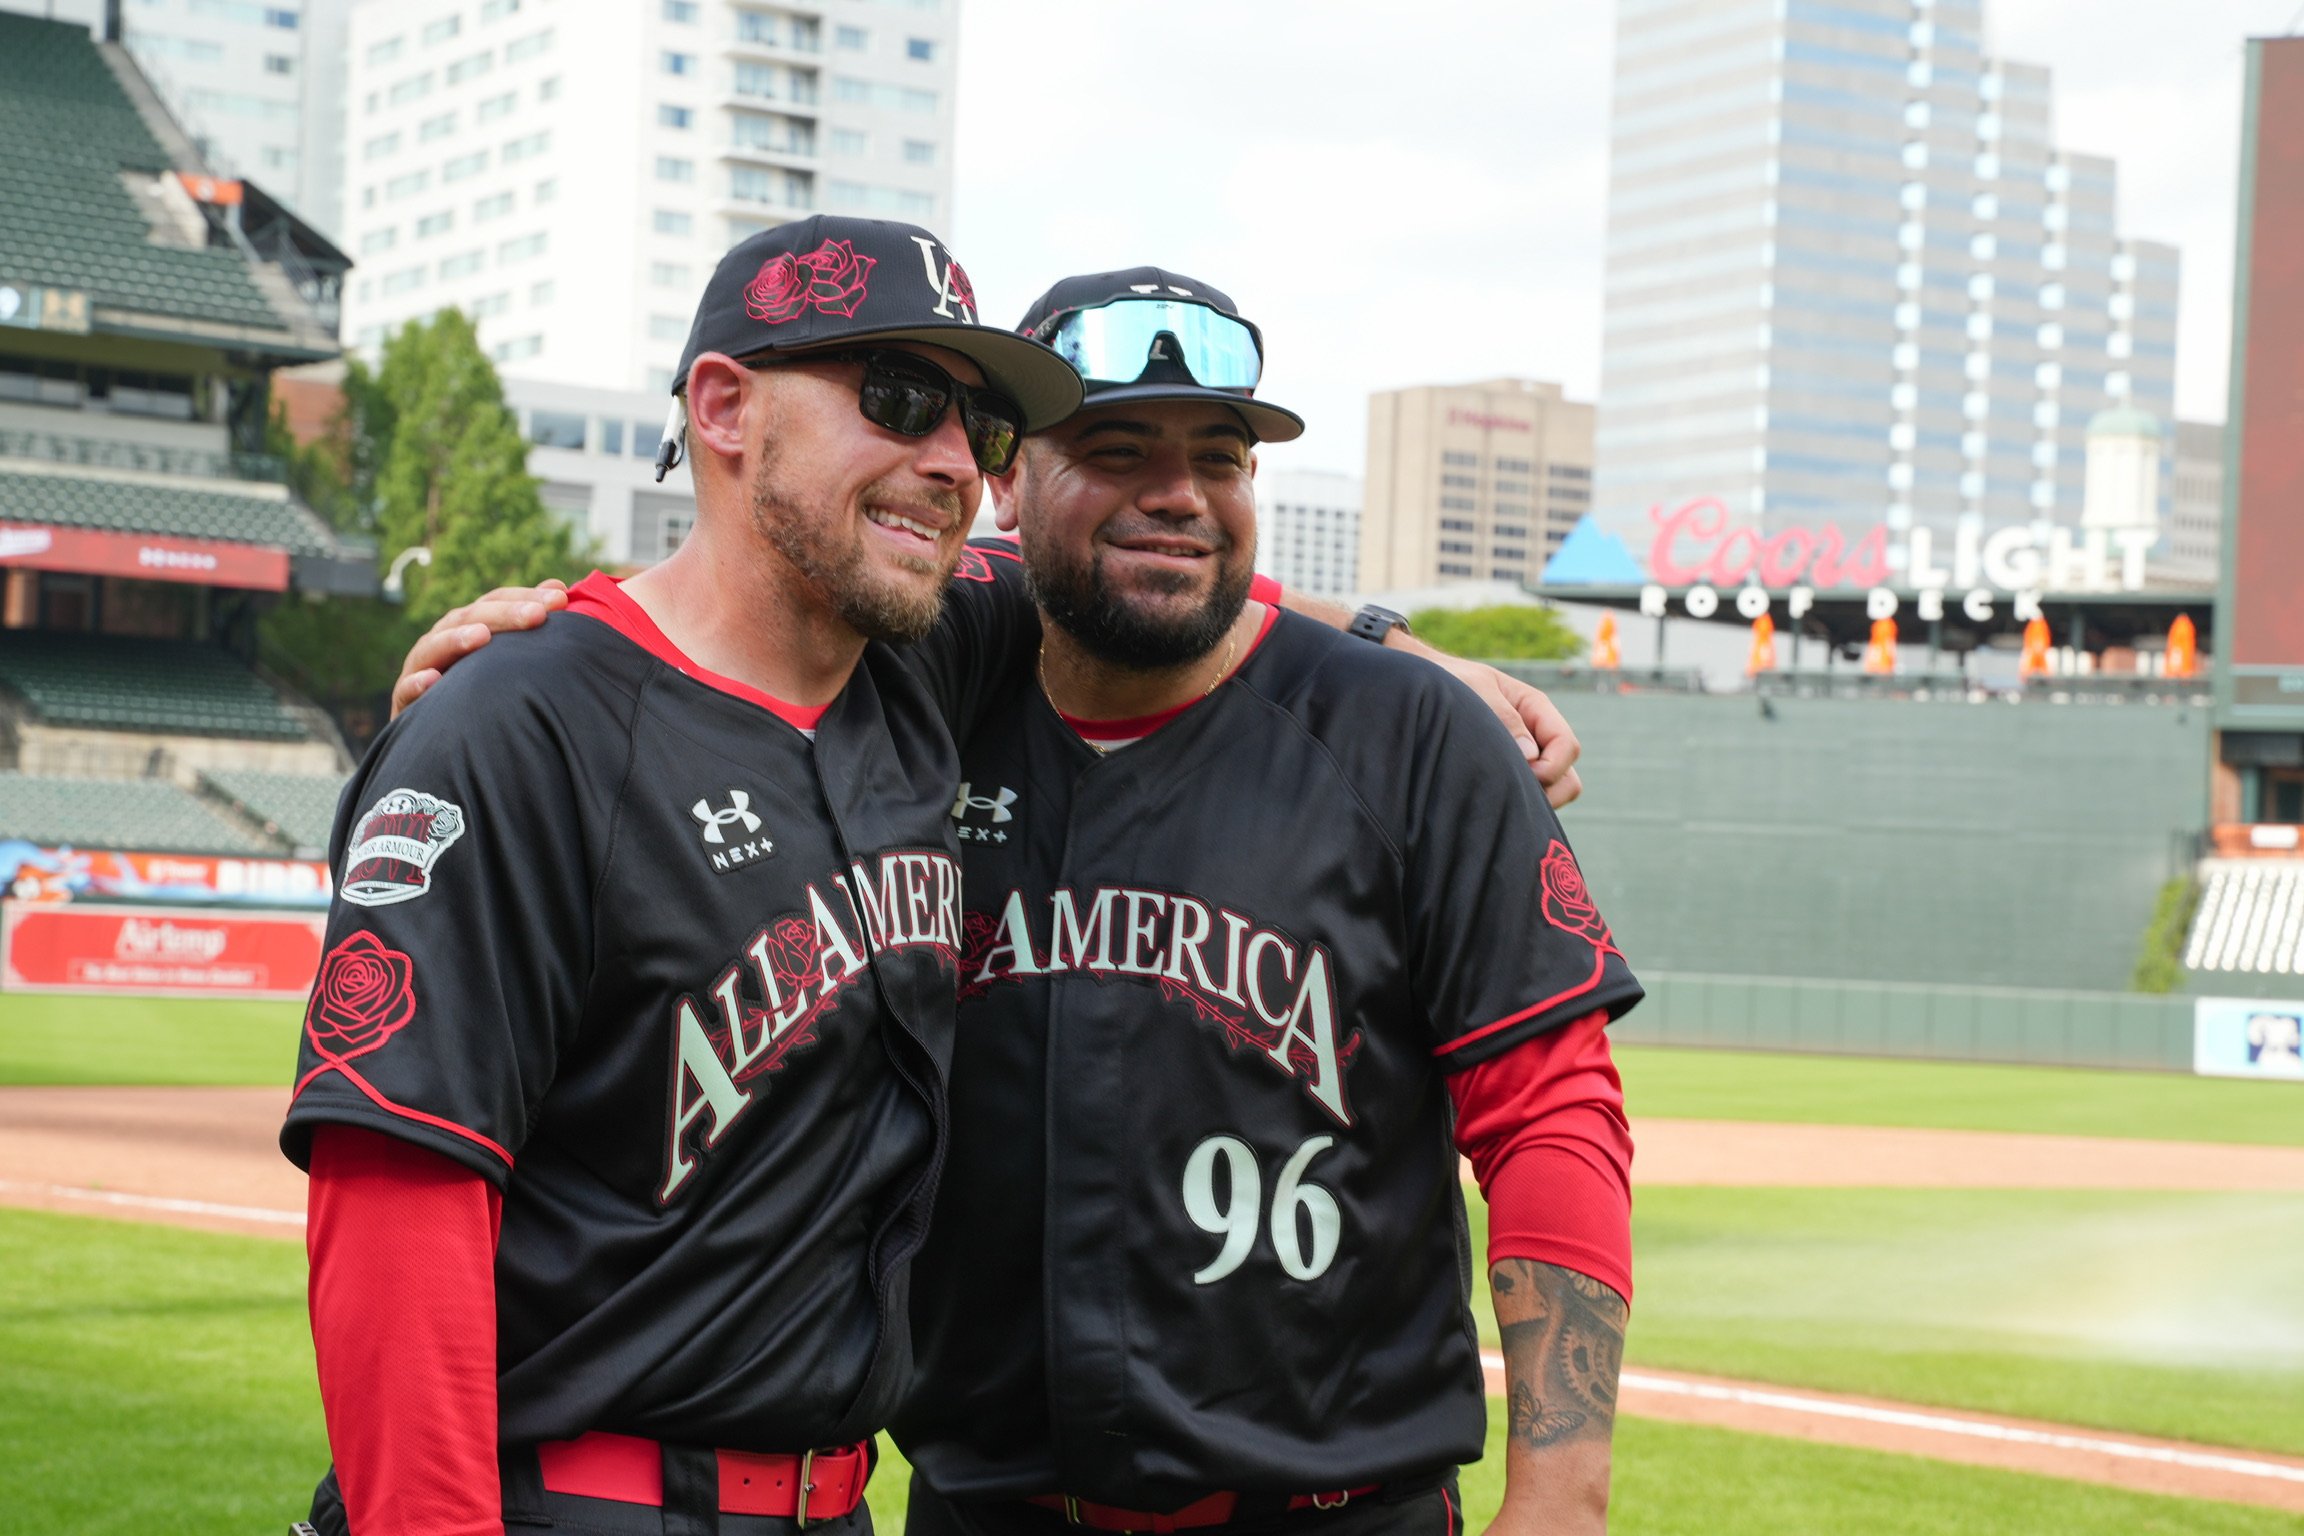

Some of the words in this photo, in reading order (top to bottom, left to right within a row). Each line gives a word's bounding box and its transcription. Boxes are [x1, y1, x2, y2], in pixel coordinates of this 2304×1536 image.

[1639, 584, 1815, 618] ROOF
[1866, 586, 2044, 622] DECK
[1649, 496, 1892, 588] Coors
[1909, 524, 2159, 592] LIGHT
[380, 840, 424, 863] ARMOUR
[658, 930, 809, 1204] ALL
[974, 887, 1352, 1128] AMERICA
[1182, 1135, 1341, 1285] 96
